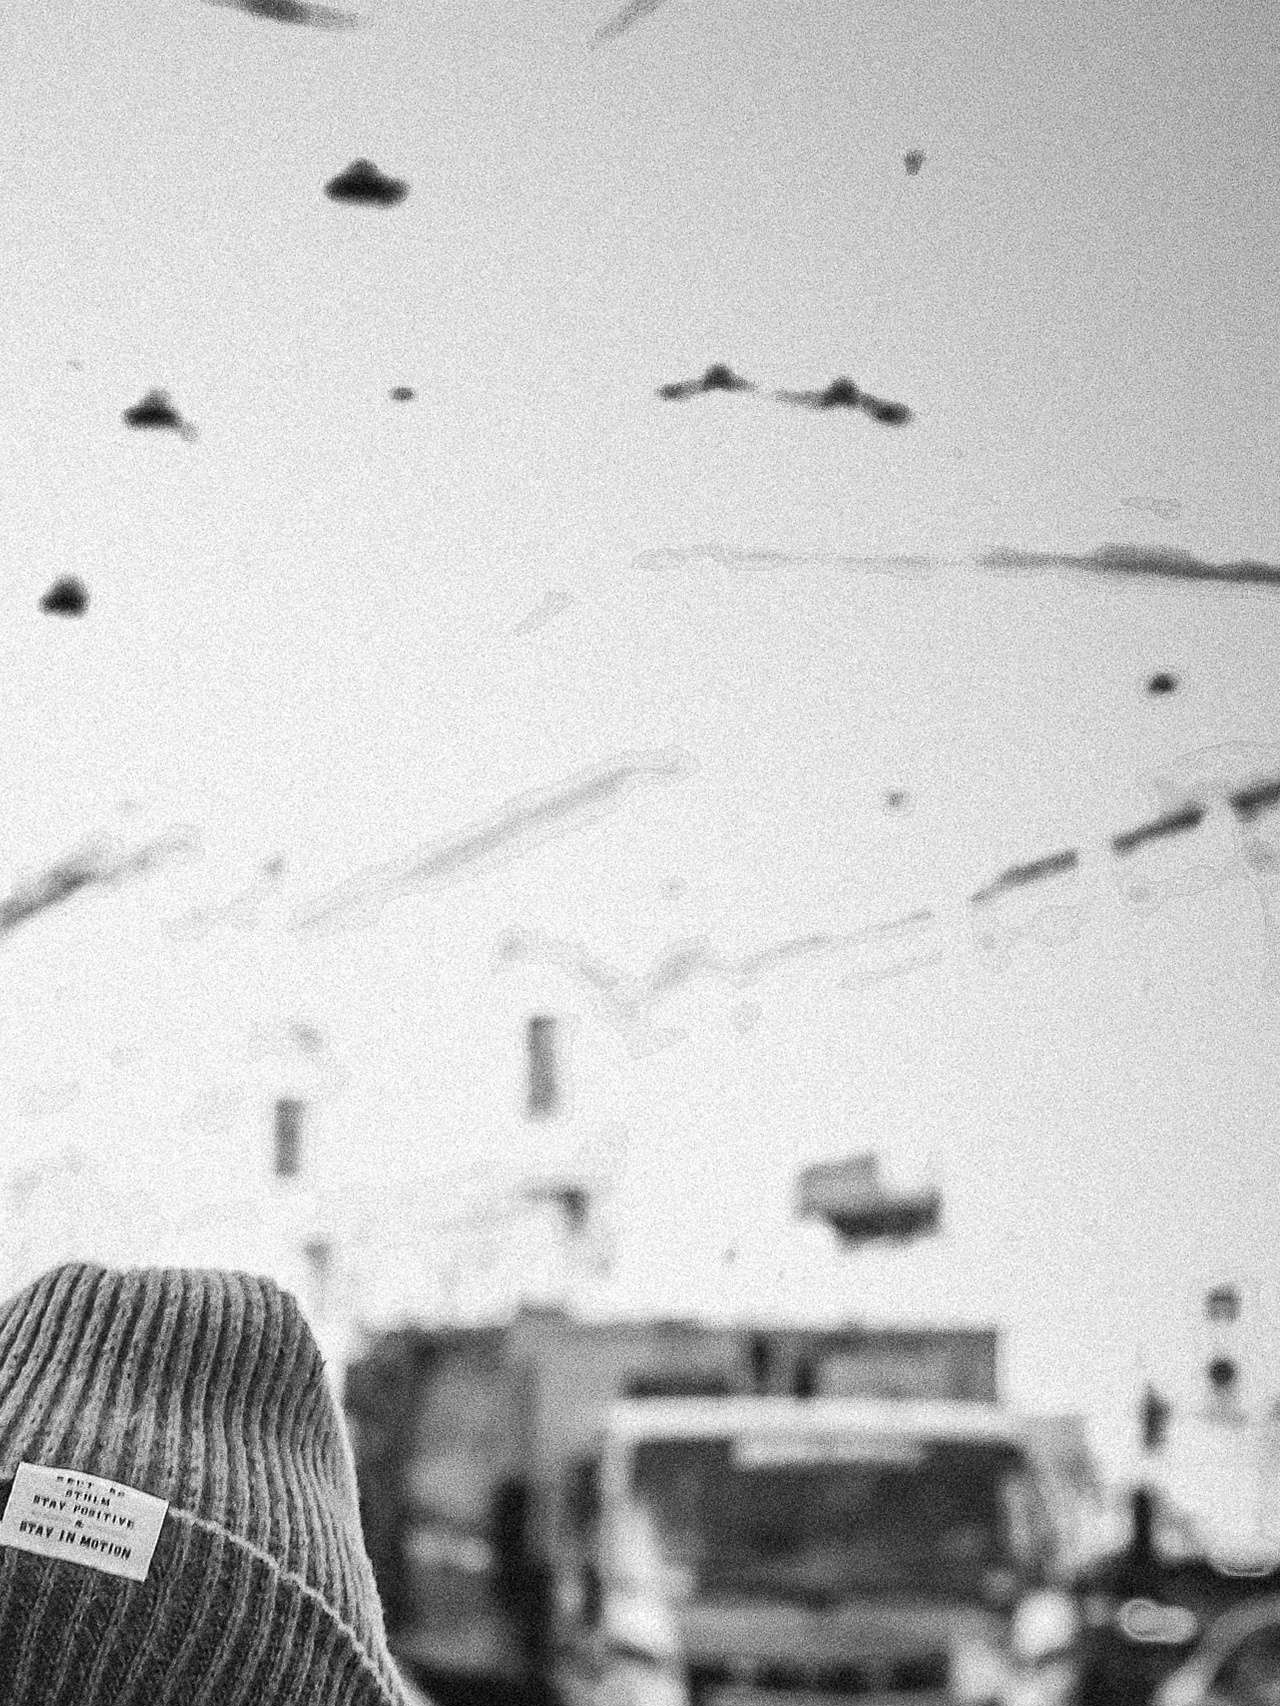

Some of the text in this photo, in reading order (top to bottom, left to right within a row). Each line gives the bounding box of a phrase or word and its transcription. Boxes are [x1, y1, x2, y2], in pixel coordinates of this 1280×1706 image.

[33, 1494, 135, 1529] STAY POSITIVE
[19, 1520, 132, 1561] STAY IN MOTION
